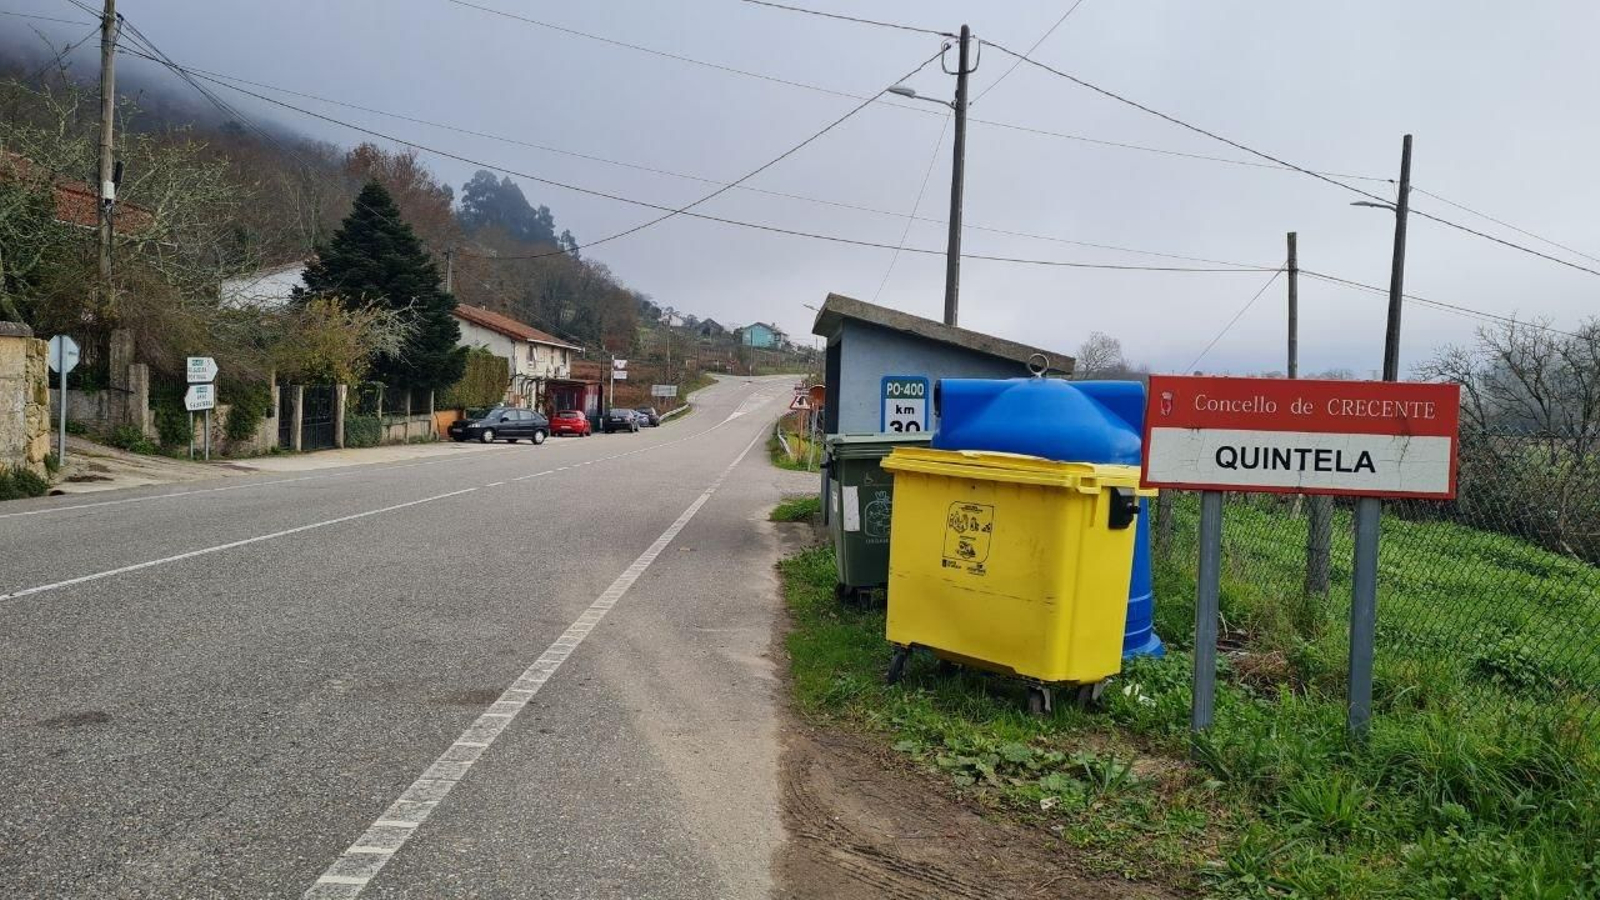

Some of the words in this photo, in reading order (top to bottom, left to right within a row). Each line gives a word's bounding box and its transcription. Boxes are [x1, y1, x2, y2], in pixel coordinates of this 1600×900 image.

[886, 382, 925, 396] PO-400
[895, 404, 915, 415] km
[1195, 394, 1277, 414] Concello
[1290, 396, 1314, 415] de
[1327, 398, 1436, 420] CRECENTE
[1215, 445, 1377, 473] QUINTELA
